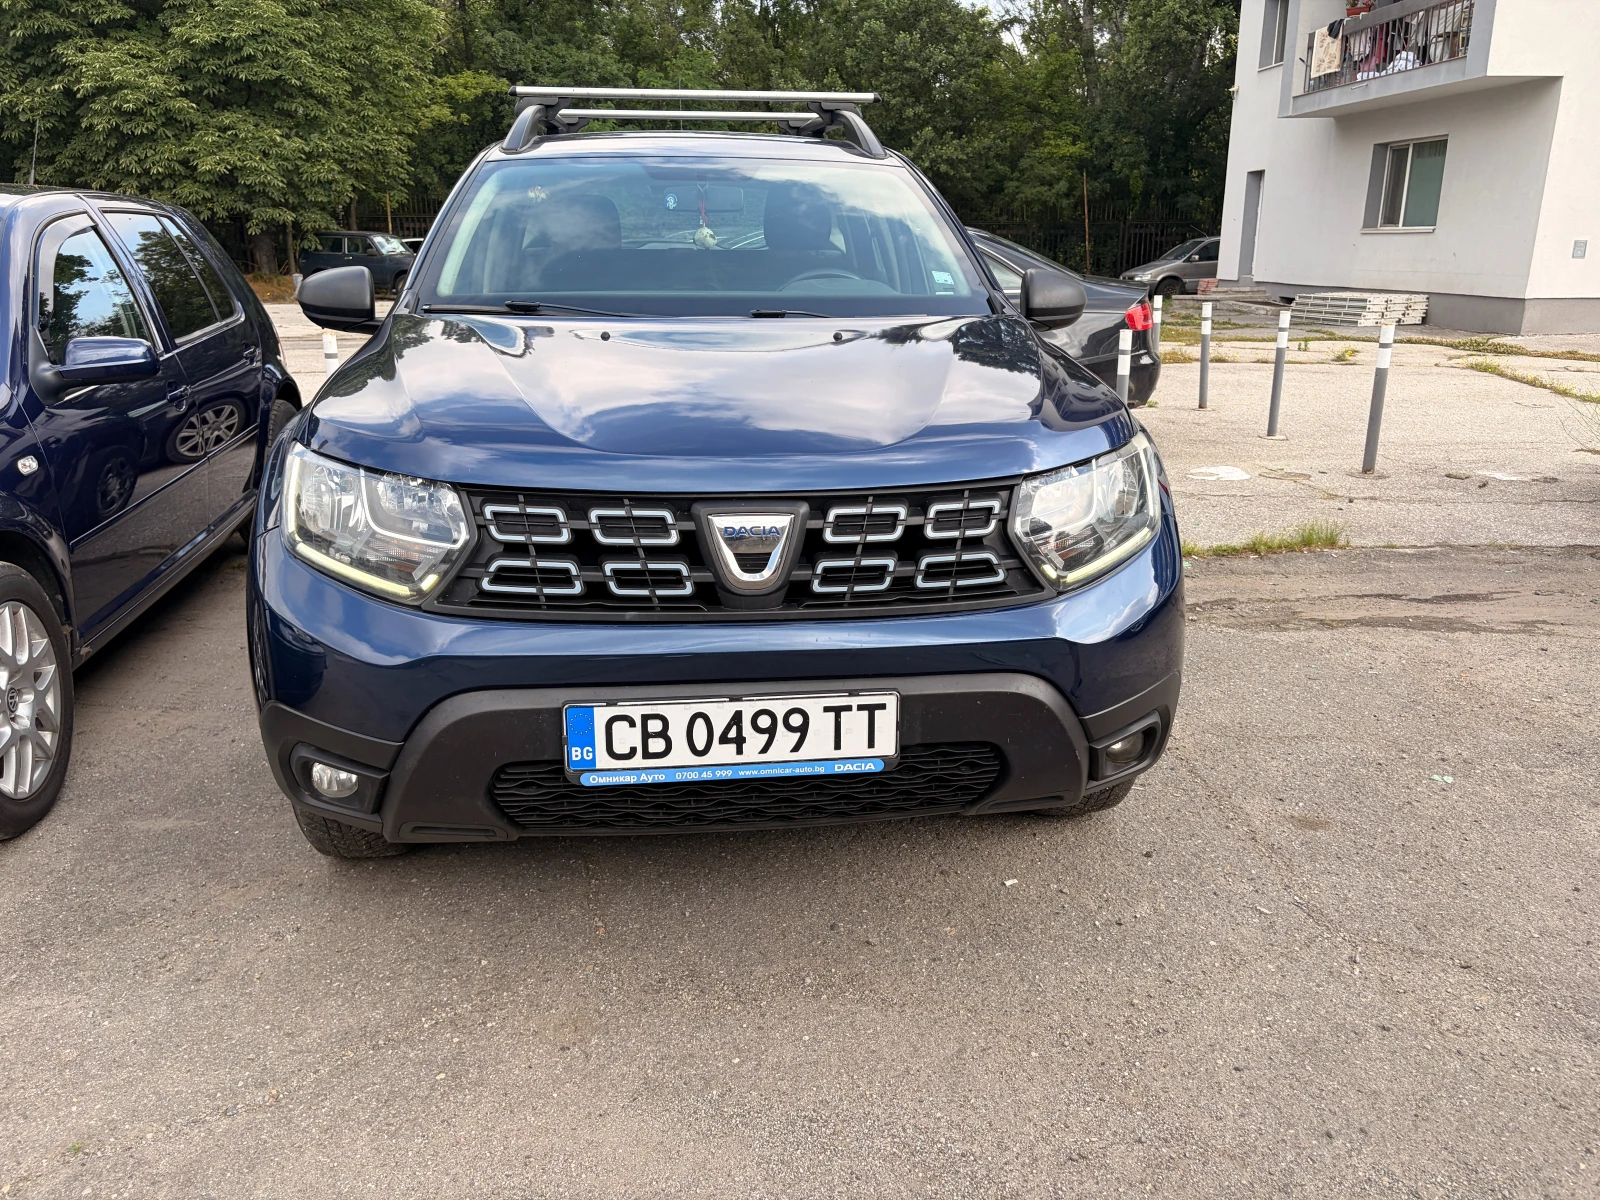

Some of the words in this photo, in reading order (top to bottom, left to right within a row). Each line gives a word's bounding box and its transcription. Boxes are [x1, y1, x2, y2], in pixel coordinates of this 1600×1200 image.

[723, 525, 781, 537] DACIA
[604, 713, 673, 761] CB
[686, 707, 810, 757] 0499
[822, 703, 887, 751] TT
[571, 746, 593, 761] BG
[738, 765, 825, 776] www.omnicar-auto.bg
[834, 763, 876, 772] DACIA
[589, 774, 637, 784] Омникар
[639, 773, 666, 783] Ауто
[675, 771, 699, 780] 0700
[700, 770, 713, 779] 45
[715, 769, 733, 778] 999
